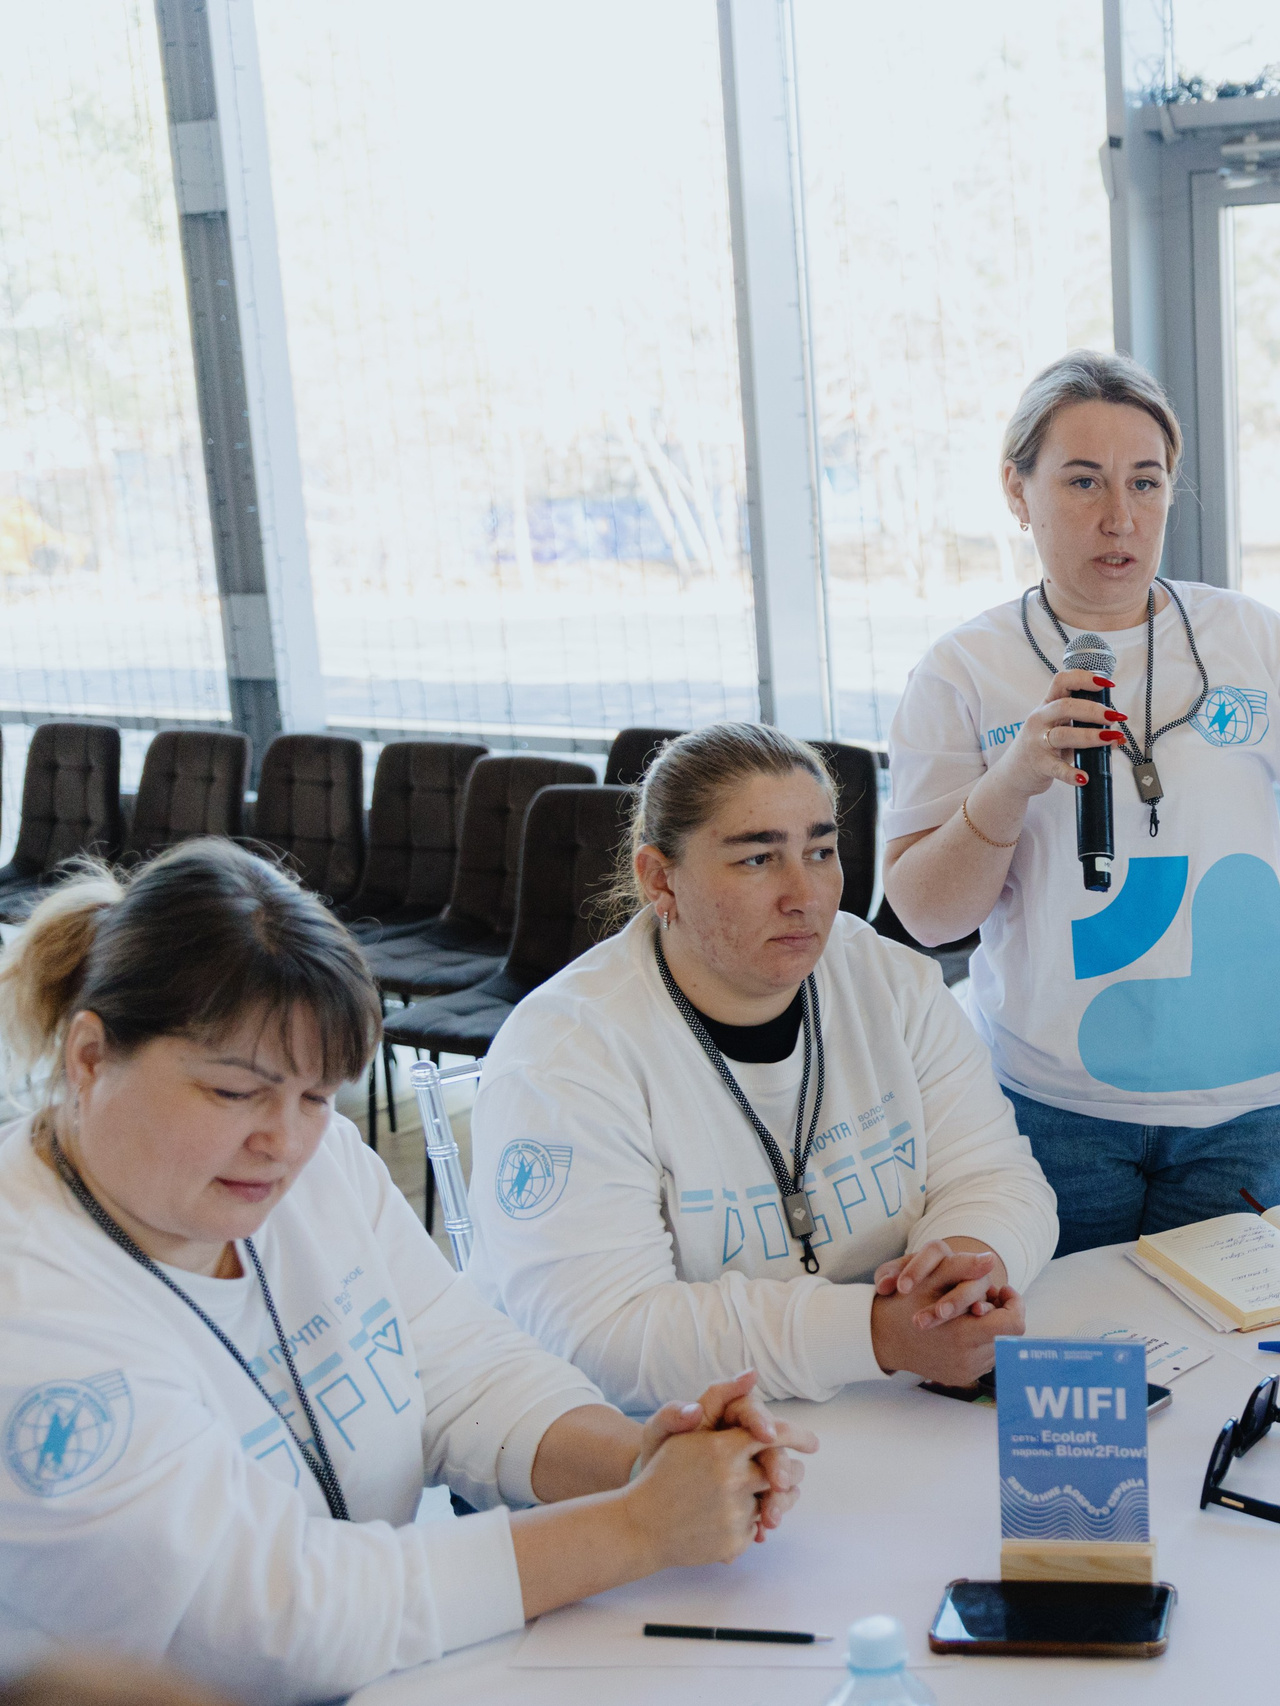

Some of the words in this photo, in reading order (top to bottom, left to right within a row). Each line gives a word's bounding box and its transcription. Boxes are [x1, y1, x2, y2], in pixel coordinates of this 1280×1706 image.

[987, 720, 1025, 748] ПОЧТ
[1025, 1386, 1127, 1420] WIFI
[1011, 1434, 1040, 1443] сеть:
[1042, 1430, 1098, 1443] Ecoloft
[1012, 1448, 1054, 1458] пароль:
[1063, 1485, 1110, 1516] ДОБРОГО
